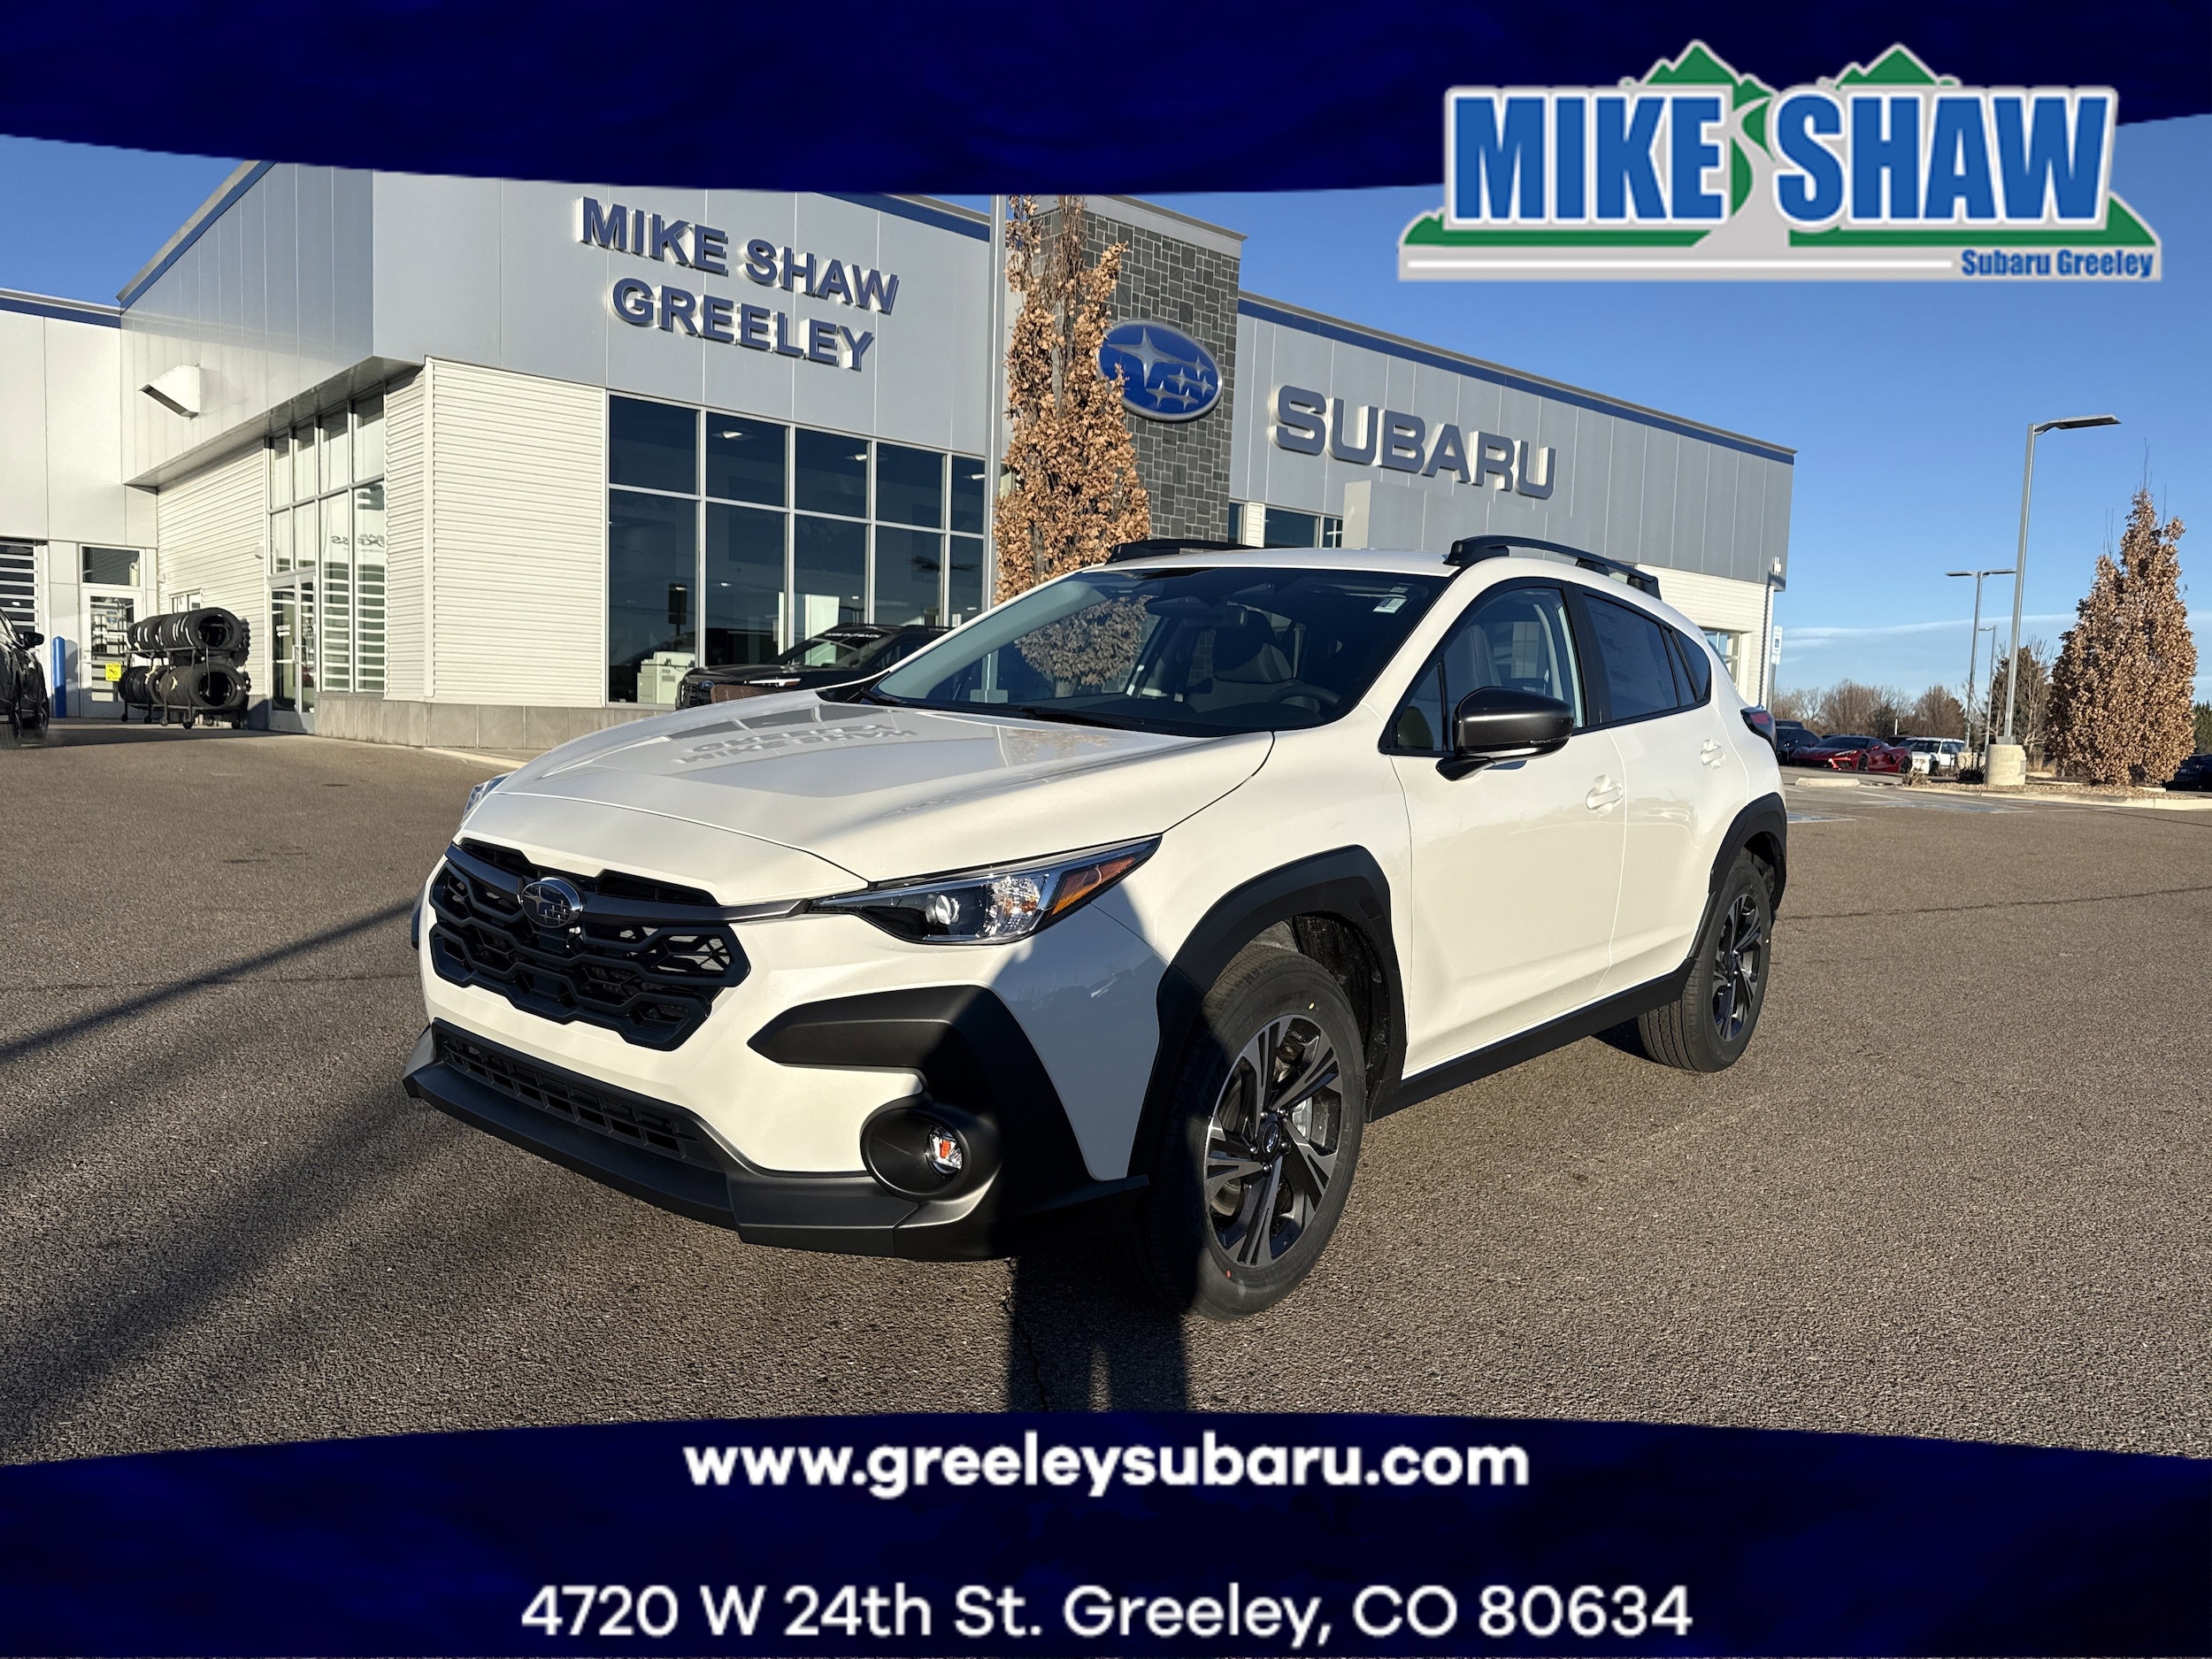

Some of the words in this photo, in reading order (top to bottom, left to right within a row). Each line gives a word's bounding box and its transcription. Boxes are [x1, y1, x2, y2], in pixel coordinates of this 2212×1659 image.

[579, 196, 729, 277] MIKE
[742, 238, 900, 316] SHAW
[611, 277, 875, 372] GREELEY
[1271, 385, 1556, 500] SUBARU
